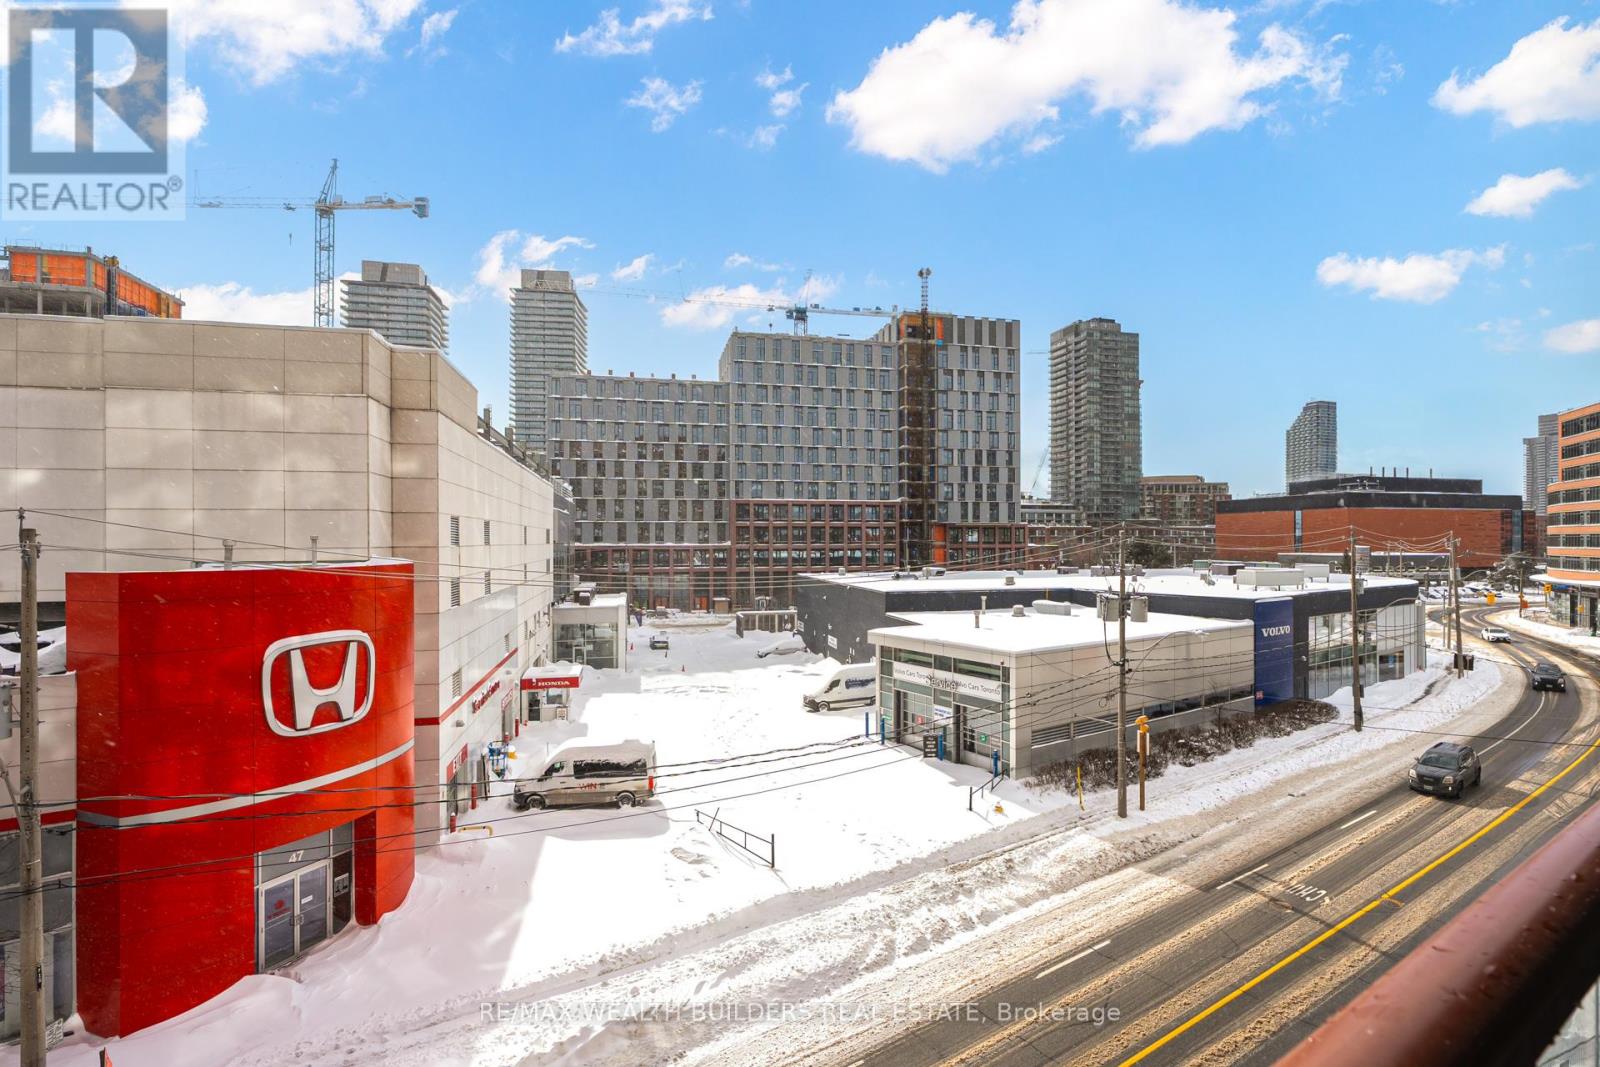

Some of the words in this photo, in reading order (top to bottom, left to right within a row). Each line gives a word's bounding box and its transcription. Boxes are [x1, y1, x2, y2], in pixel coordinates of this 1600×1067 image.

[1261, 625, 1290, 637] VOLVO
[968, 682, 979, 691] Cars
[980, 685, 1000, 696] Toronto
